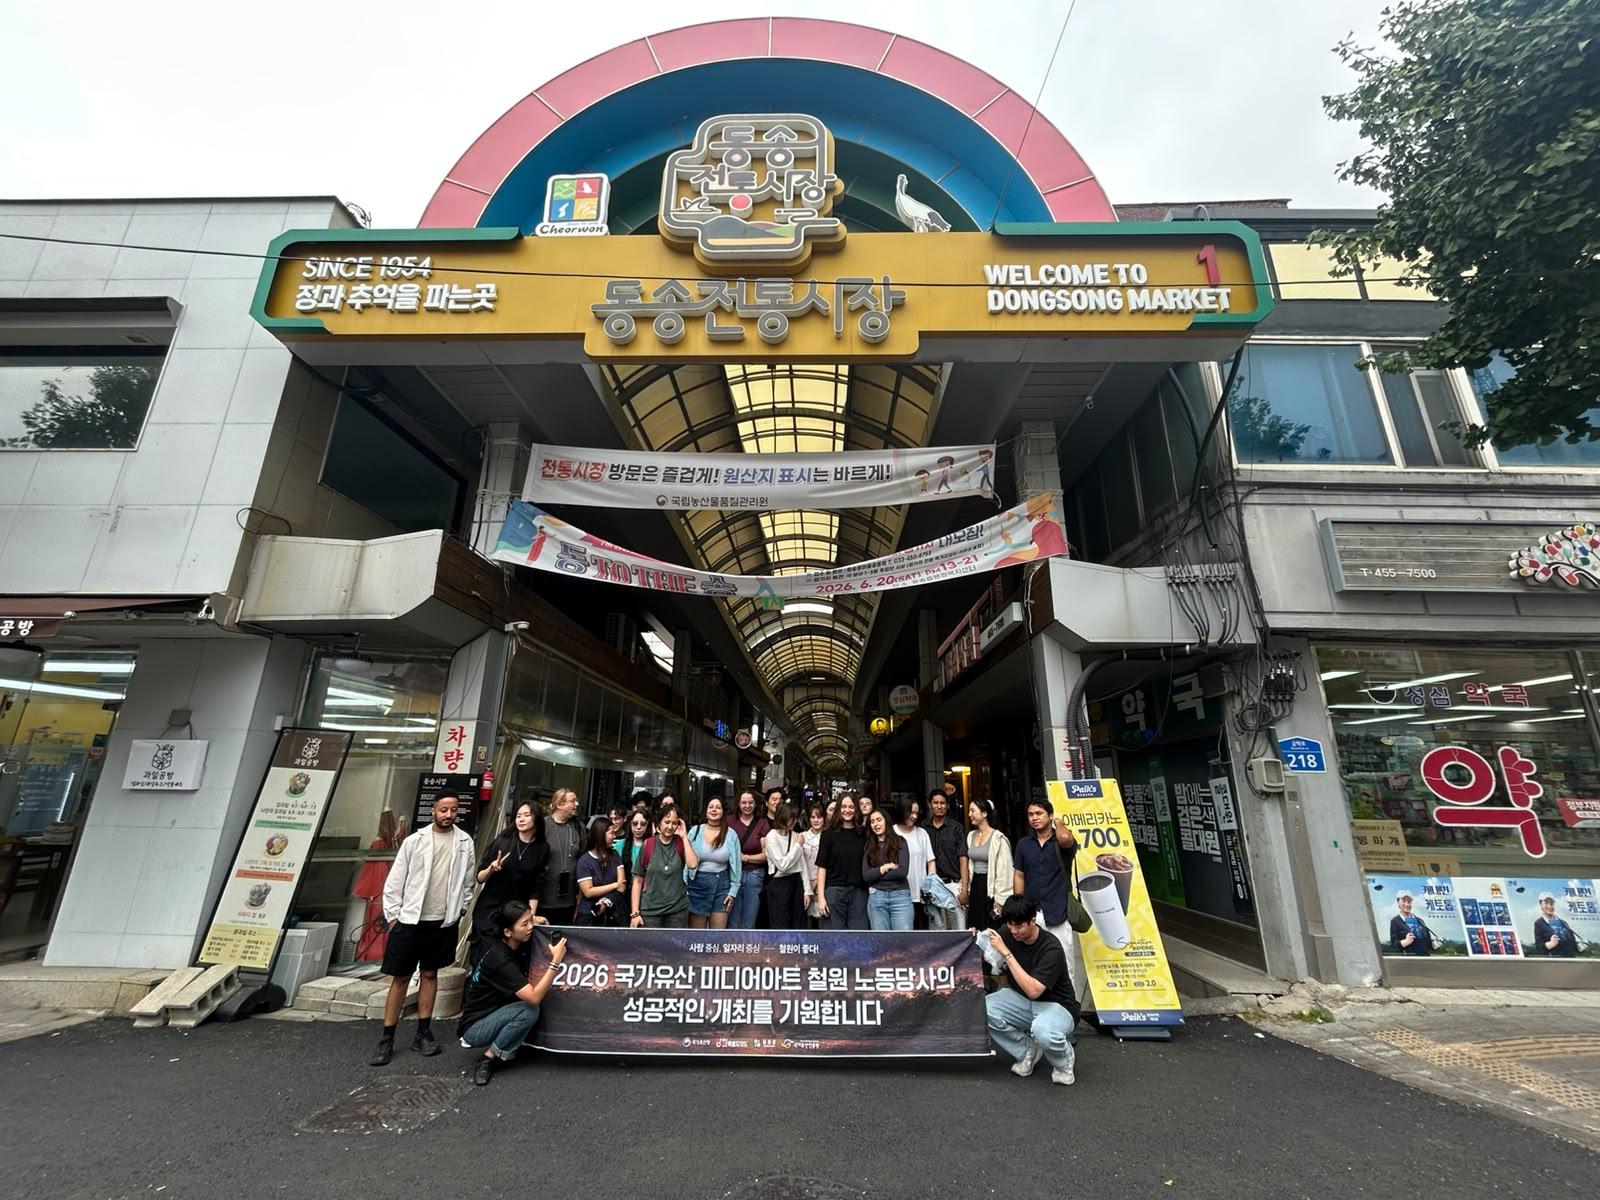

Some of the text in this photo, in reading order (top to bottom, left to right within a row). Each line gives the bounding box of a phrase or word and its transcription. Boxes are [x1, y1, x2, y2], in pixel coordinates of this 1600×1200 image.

[539, 224, 604, 234] Cheorwon
[302, 256, 433, 280] SINCE 1954
[983, 263, 1148, 286] WELCOME TO
[1194, 244, 1221, 288] 1
[295, 283, 498, 313] 정과 추억을 파는곳
[591, 275, 907, 344] 동송전통시장
[986, 288, 1231, 314] DONGSONG MARKET
[540, 458, 893, 485] 전통시장 방문은 즐겁게! 원산지 표시는 바르게!
[671, 496, 768, 508] 국립농산물품질관리원
[815, 582, 856, 594] 2026.
[860, 577, 873, 589] 6.
[1403, 686, 1452, 709] 성심
[1287, 753, 1318, 768] 218
[144, 770, 175, 780] 과일공방
[1071, 784, 1097, 794] Paik's
[1420, 745, 1547, 858] 약
[1062, 812, 1124, 827] 아메리카노
[688, 943, 705, 953] 사람
[723, 943, 744, 953] 일자리
[745, 944, 760, 953] 중심
[779, 944, 800, 954] 철원이
[801, 944, 819, 954] 좋다!
[552, 963, 955, 992] 2026 국가유산 미디어아트 철원 노동당사의
[622, 996, 884, 1026] 성공적인 개최를 기원합니다
[1120, 1011, 1147, 1022] Paik's
